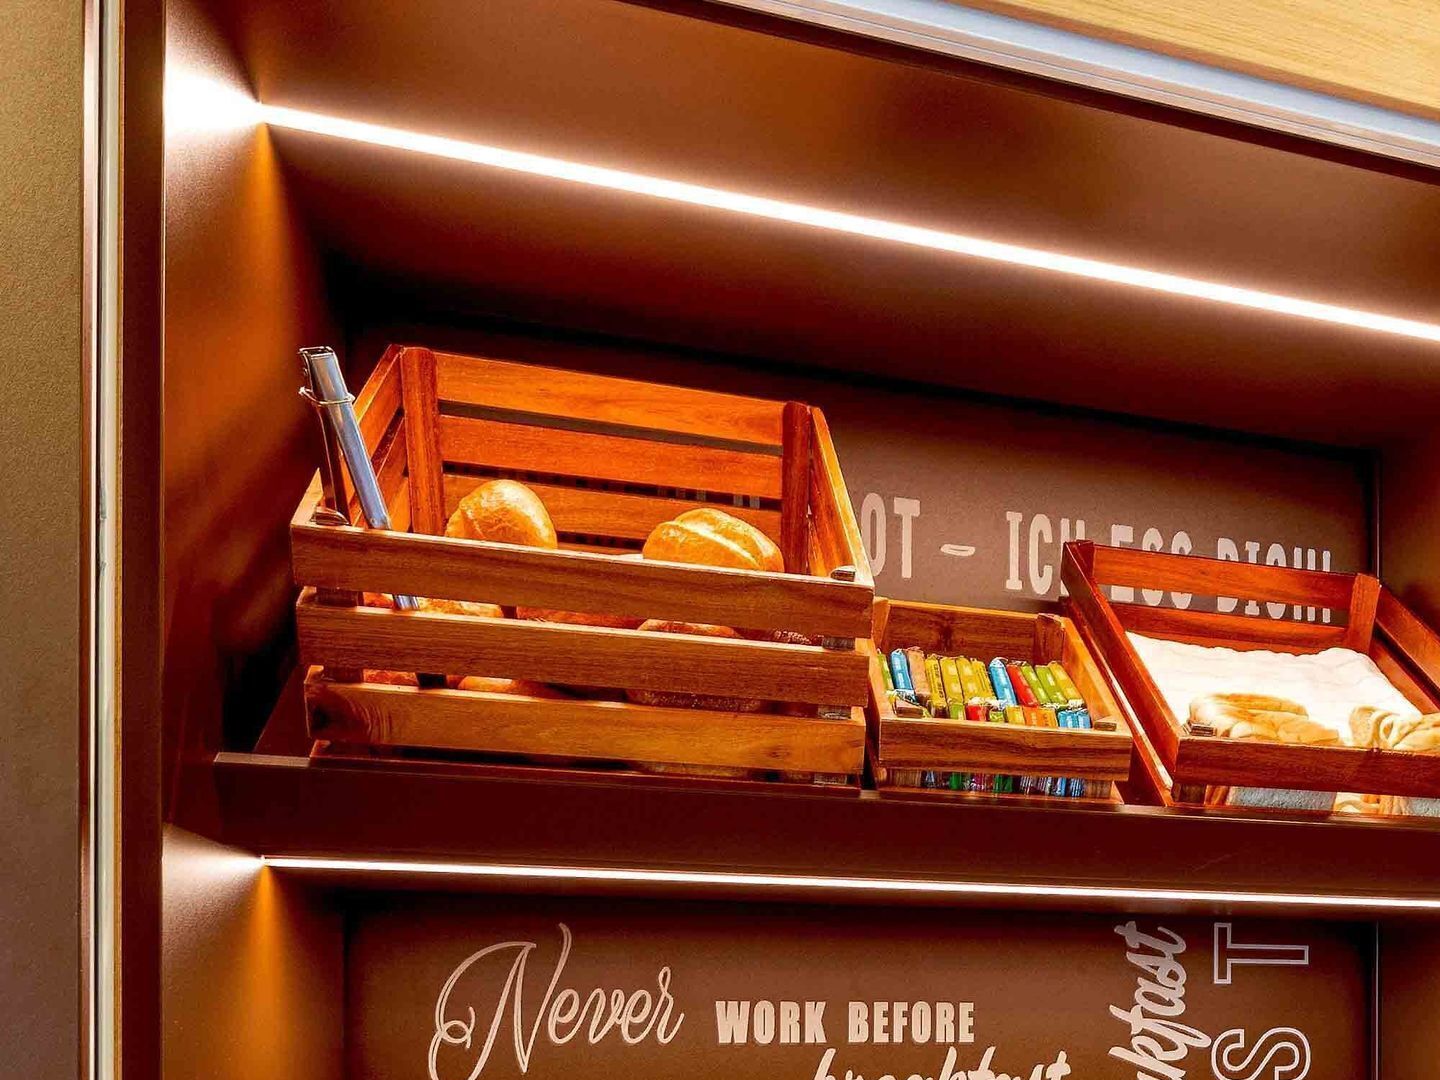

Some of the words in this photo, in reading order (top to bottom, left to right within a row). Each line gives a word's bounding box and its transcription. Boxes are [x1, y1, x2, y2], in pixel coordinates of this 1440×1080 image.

[861, 493, 920, 578] OT
[716, 1000, 827, 1044] WORK
[848, 1000, 975, 1044] BEFORE
